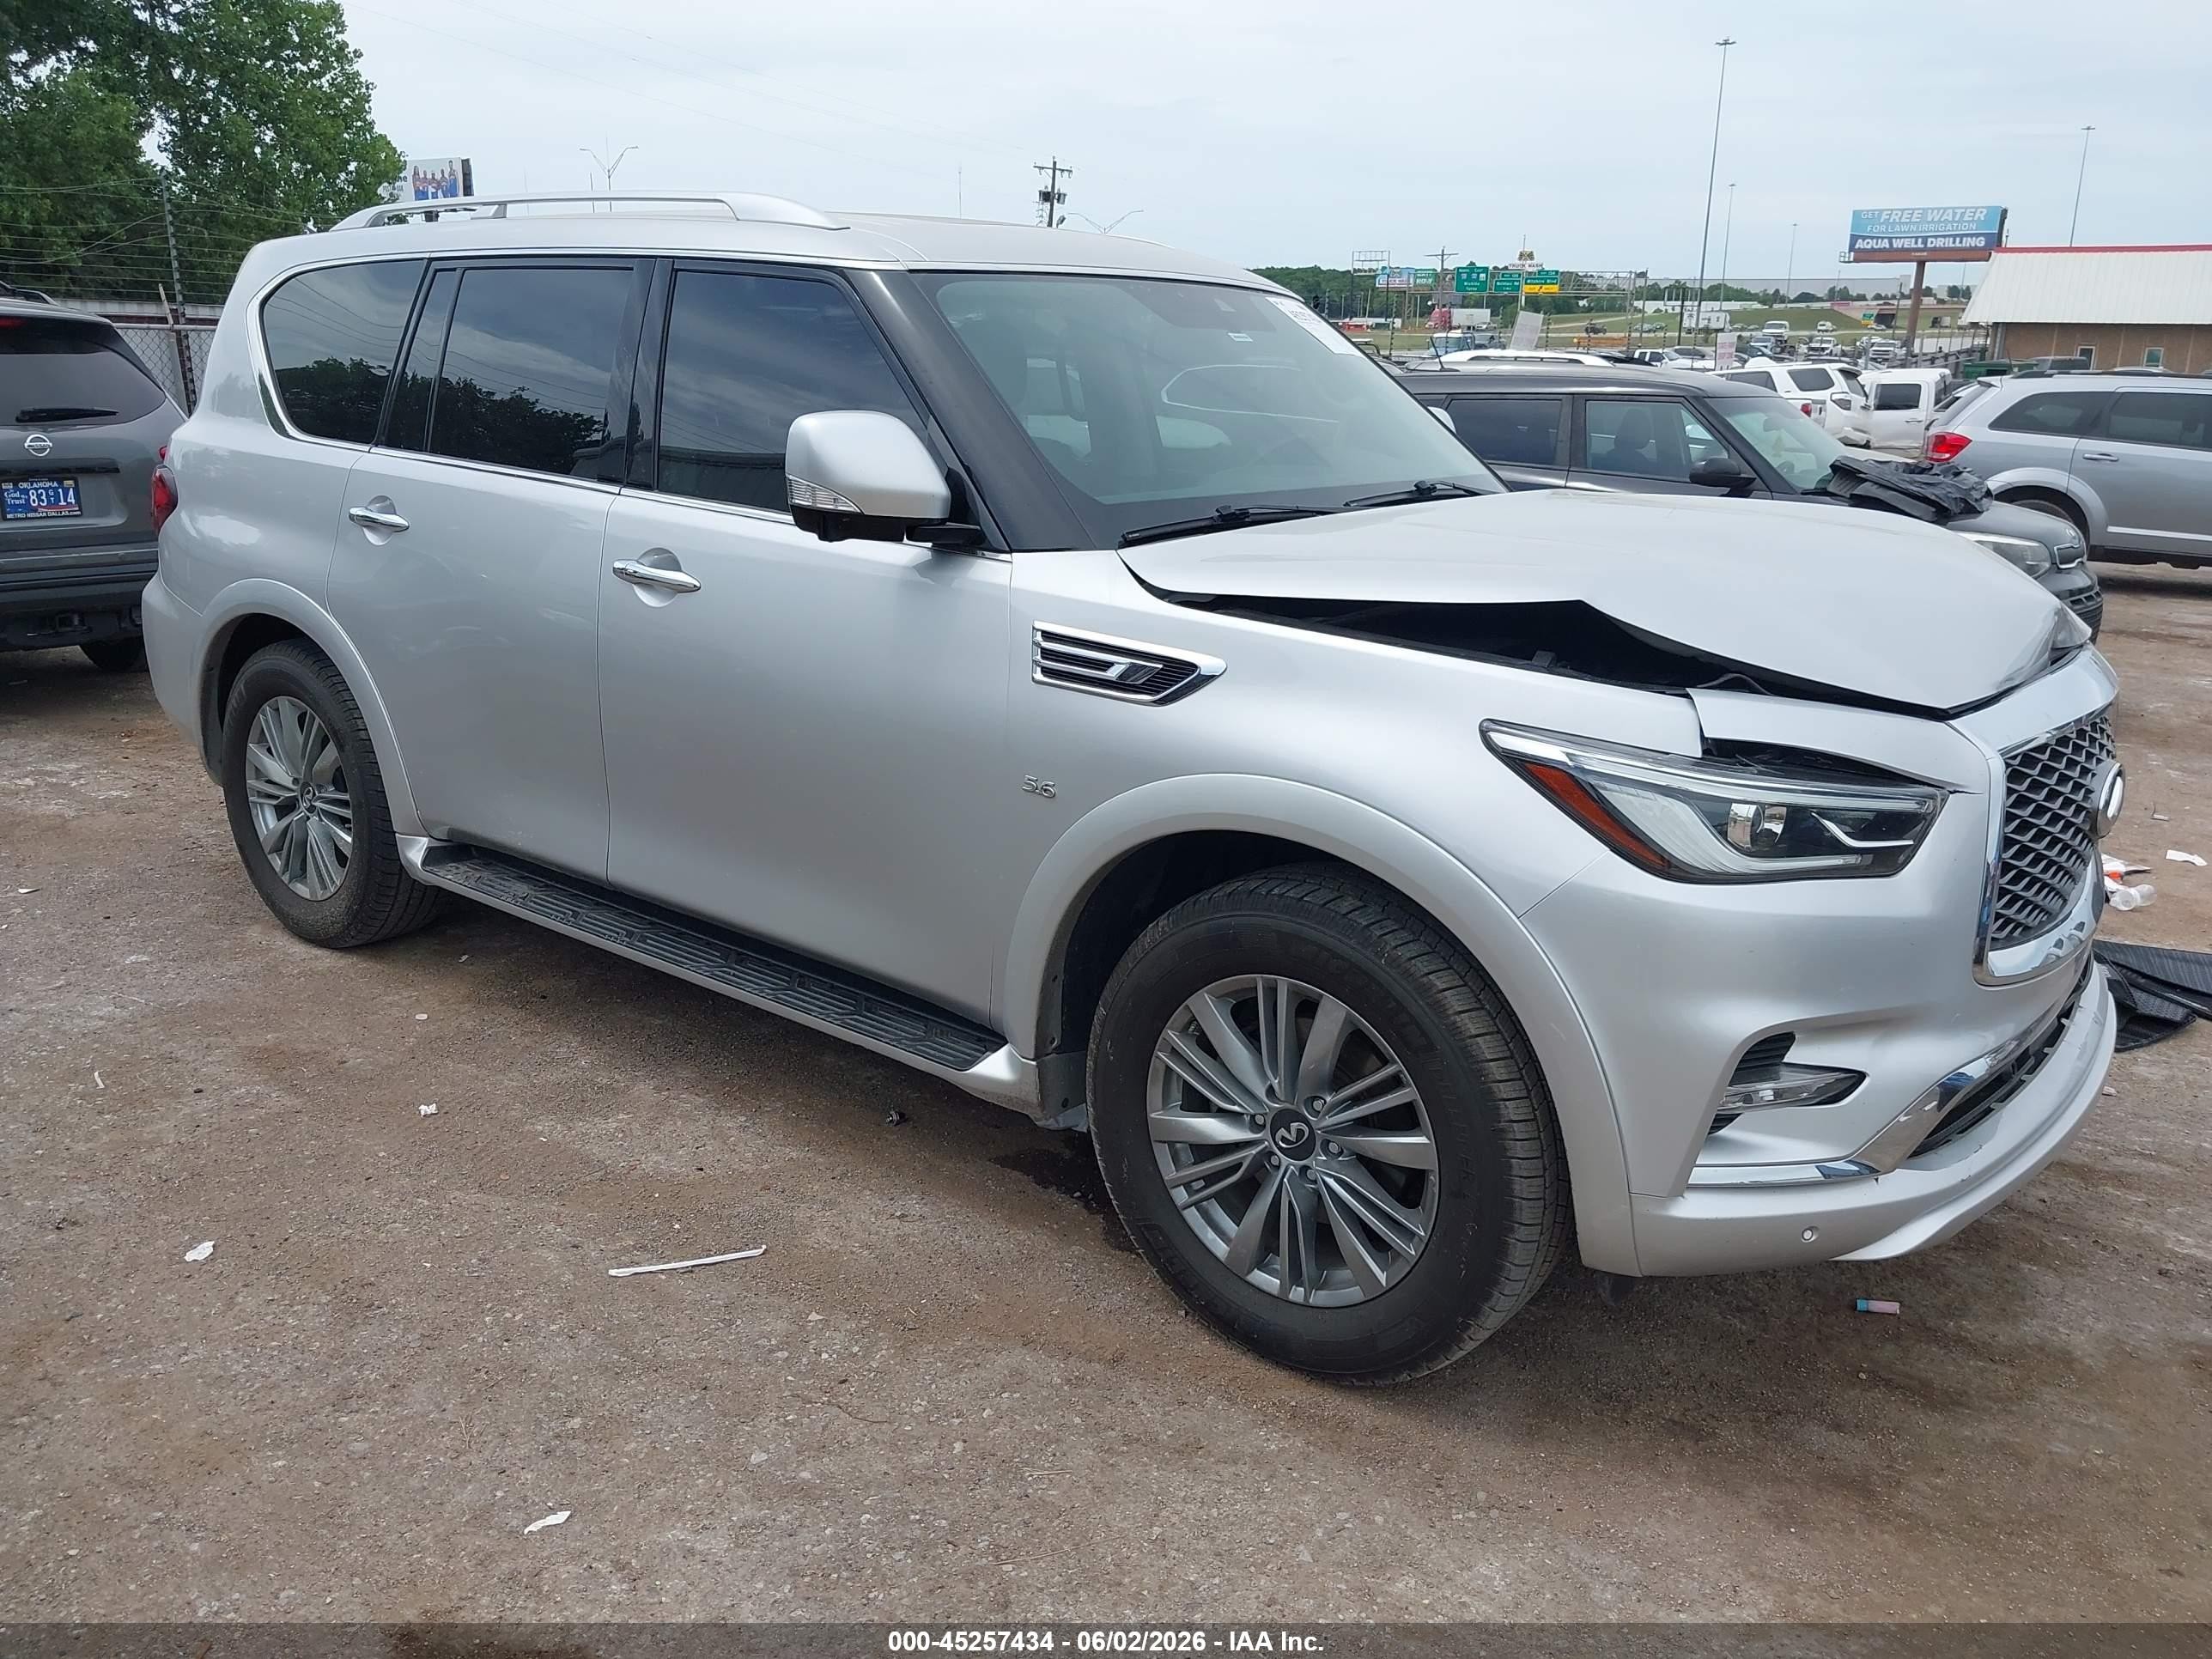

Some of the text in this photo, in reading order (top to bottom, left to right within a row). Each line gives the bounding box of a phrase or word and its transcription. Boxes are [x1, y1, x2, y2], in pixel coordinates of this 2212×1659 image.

[1880, 210, 1924, 222] FREE
[1927, 208, 1987, 222] WATER
[1919, 222, 1977, 232] IRRIGATION
[1855, 237, 1985, 249] AQUA WELL DRILLING
[29, 489, 47, 507] 83
[58, 488, 76, 506] 14
